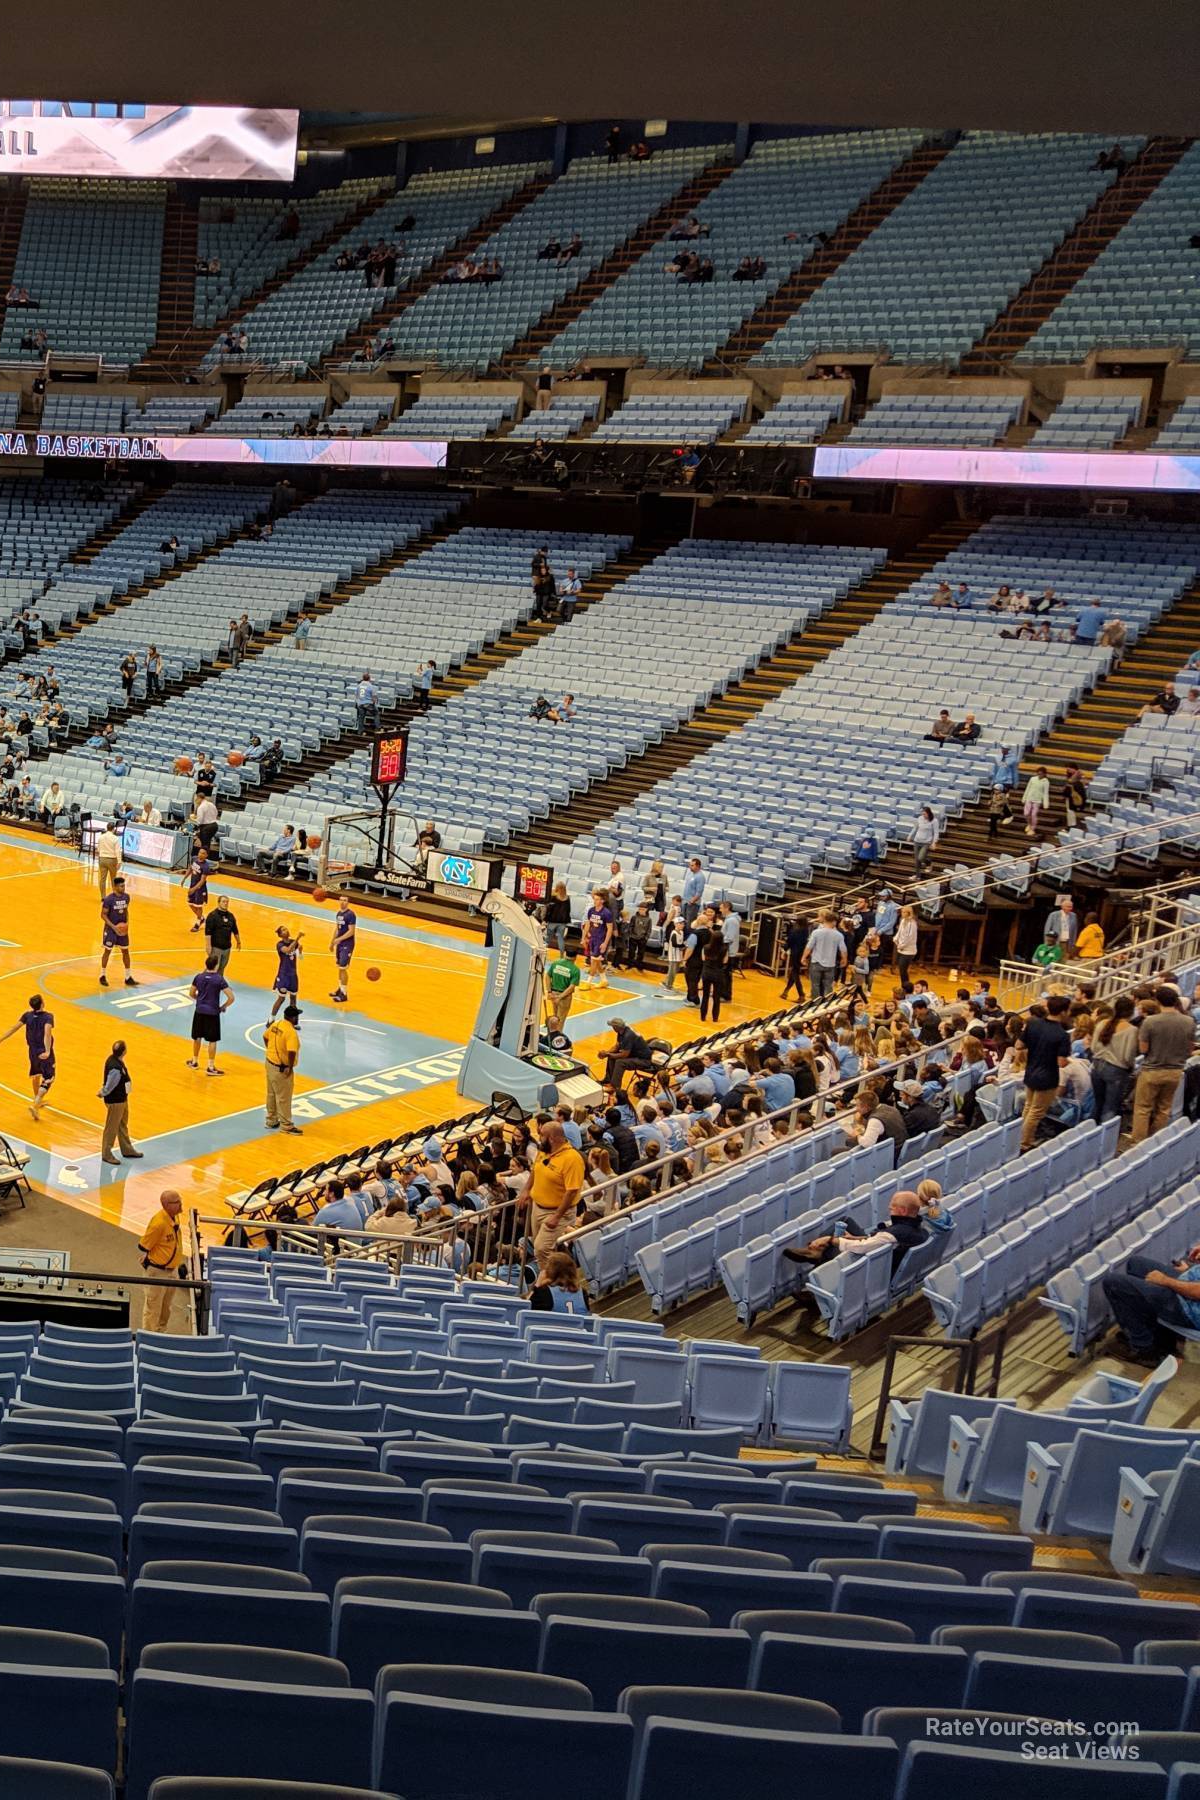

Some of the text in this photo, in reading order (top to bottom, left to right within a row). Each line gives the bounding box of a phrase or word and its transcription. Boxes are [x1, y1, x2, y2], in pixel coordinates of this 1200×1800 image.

[36, 433, 162, 460] BASKETBALL
[380, 754, 398, 778] 30
[520, 866, 549, 882] 56:20
[525, 880, 541, 896] 30
[494, 934, 513, 997] @GOHEELS
